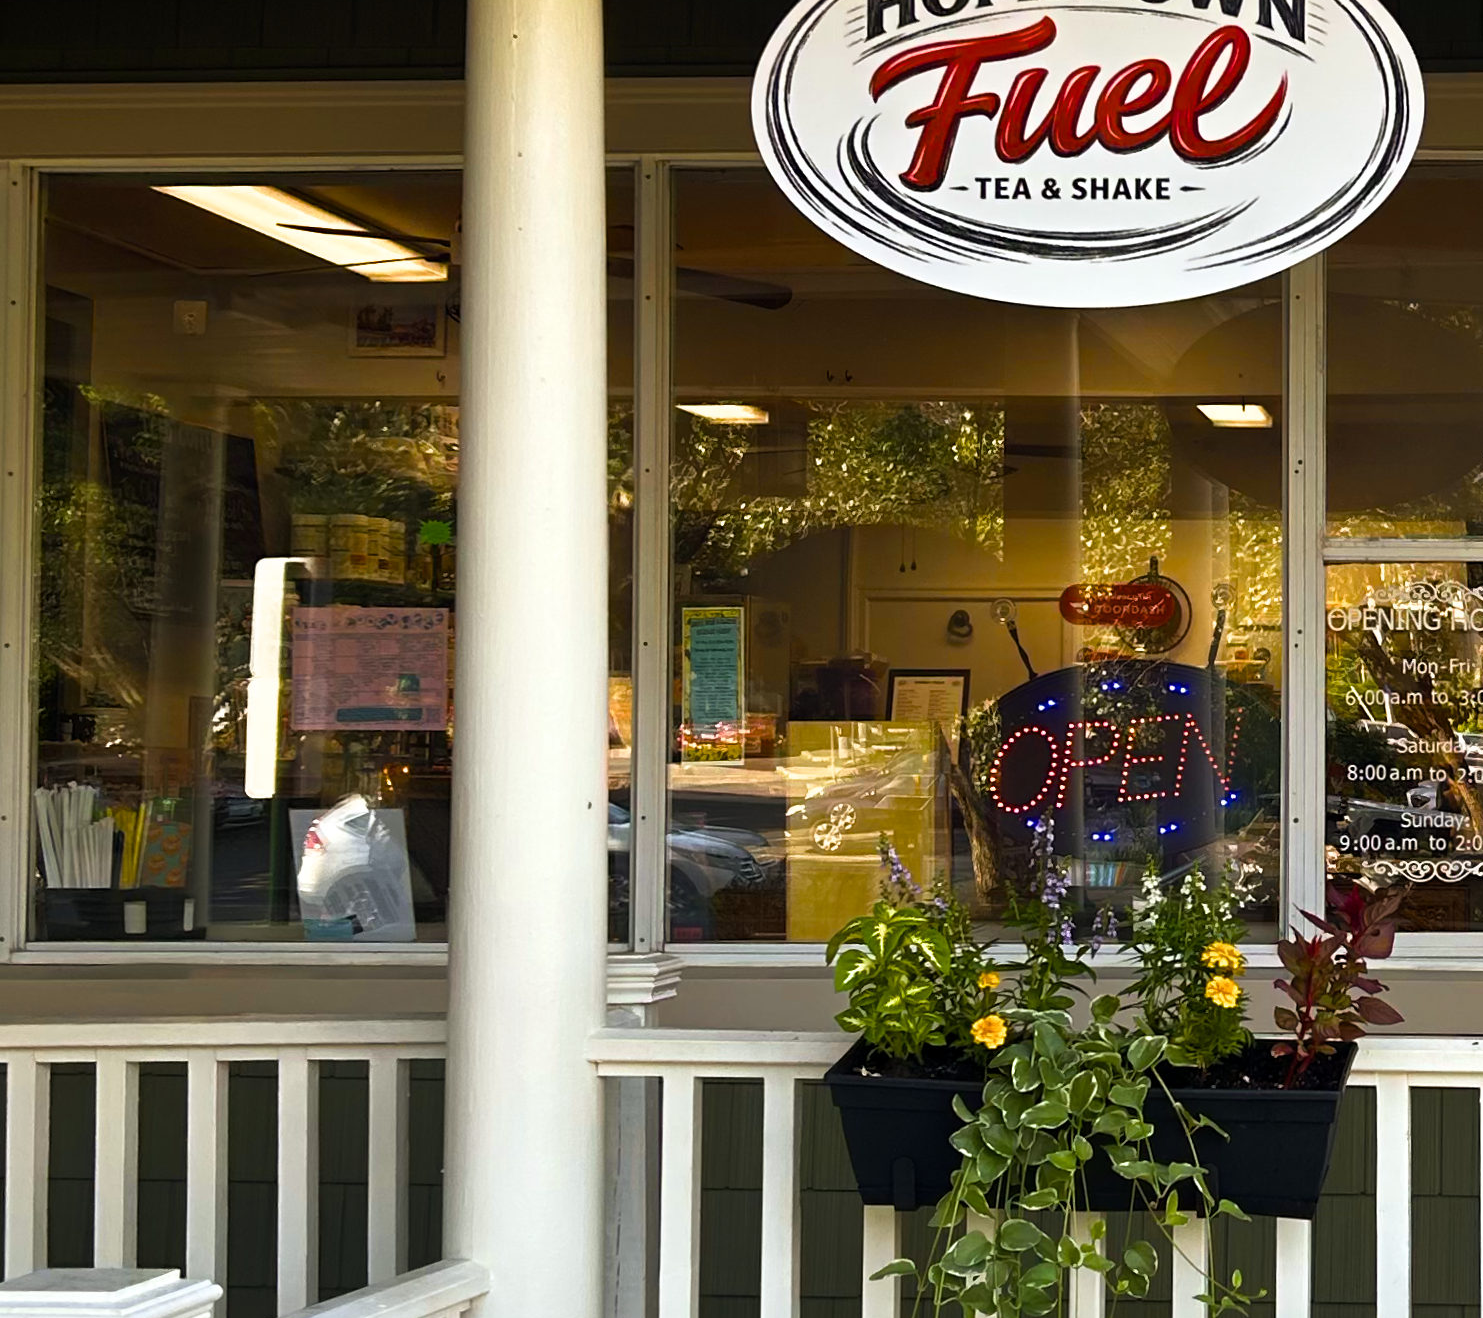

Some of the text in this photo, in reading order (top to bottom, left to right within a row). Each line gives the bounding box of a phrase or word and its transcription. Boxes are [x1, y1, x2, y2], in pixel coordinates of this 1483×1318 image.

[868, 15, 1289, 193] Fuel
[974, 177, 1170, 200] TEA & SHAKE
[1327, 608, 1441, 632] OPENING
[1431, 690, 1449, 704] to
[989, 707, 1244, 815] OPEN
[1347, 764, 1387, 781] 8:00
[1429, 767, 1447, 782] to
[1400, 813, 1470, 831] Sunday:
[1339, 835, 1382, 852] 9:00
[1429, 835, 1447, 851] to
